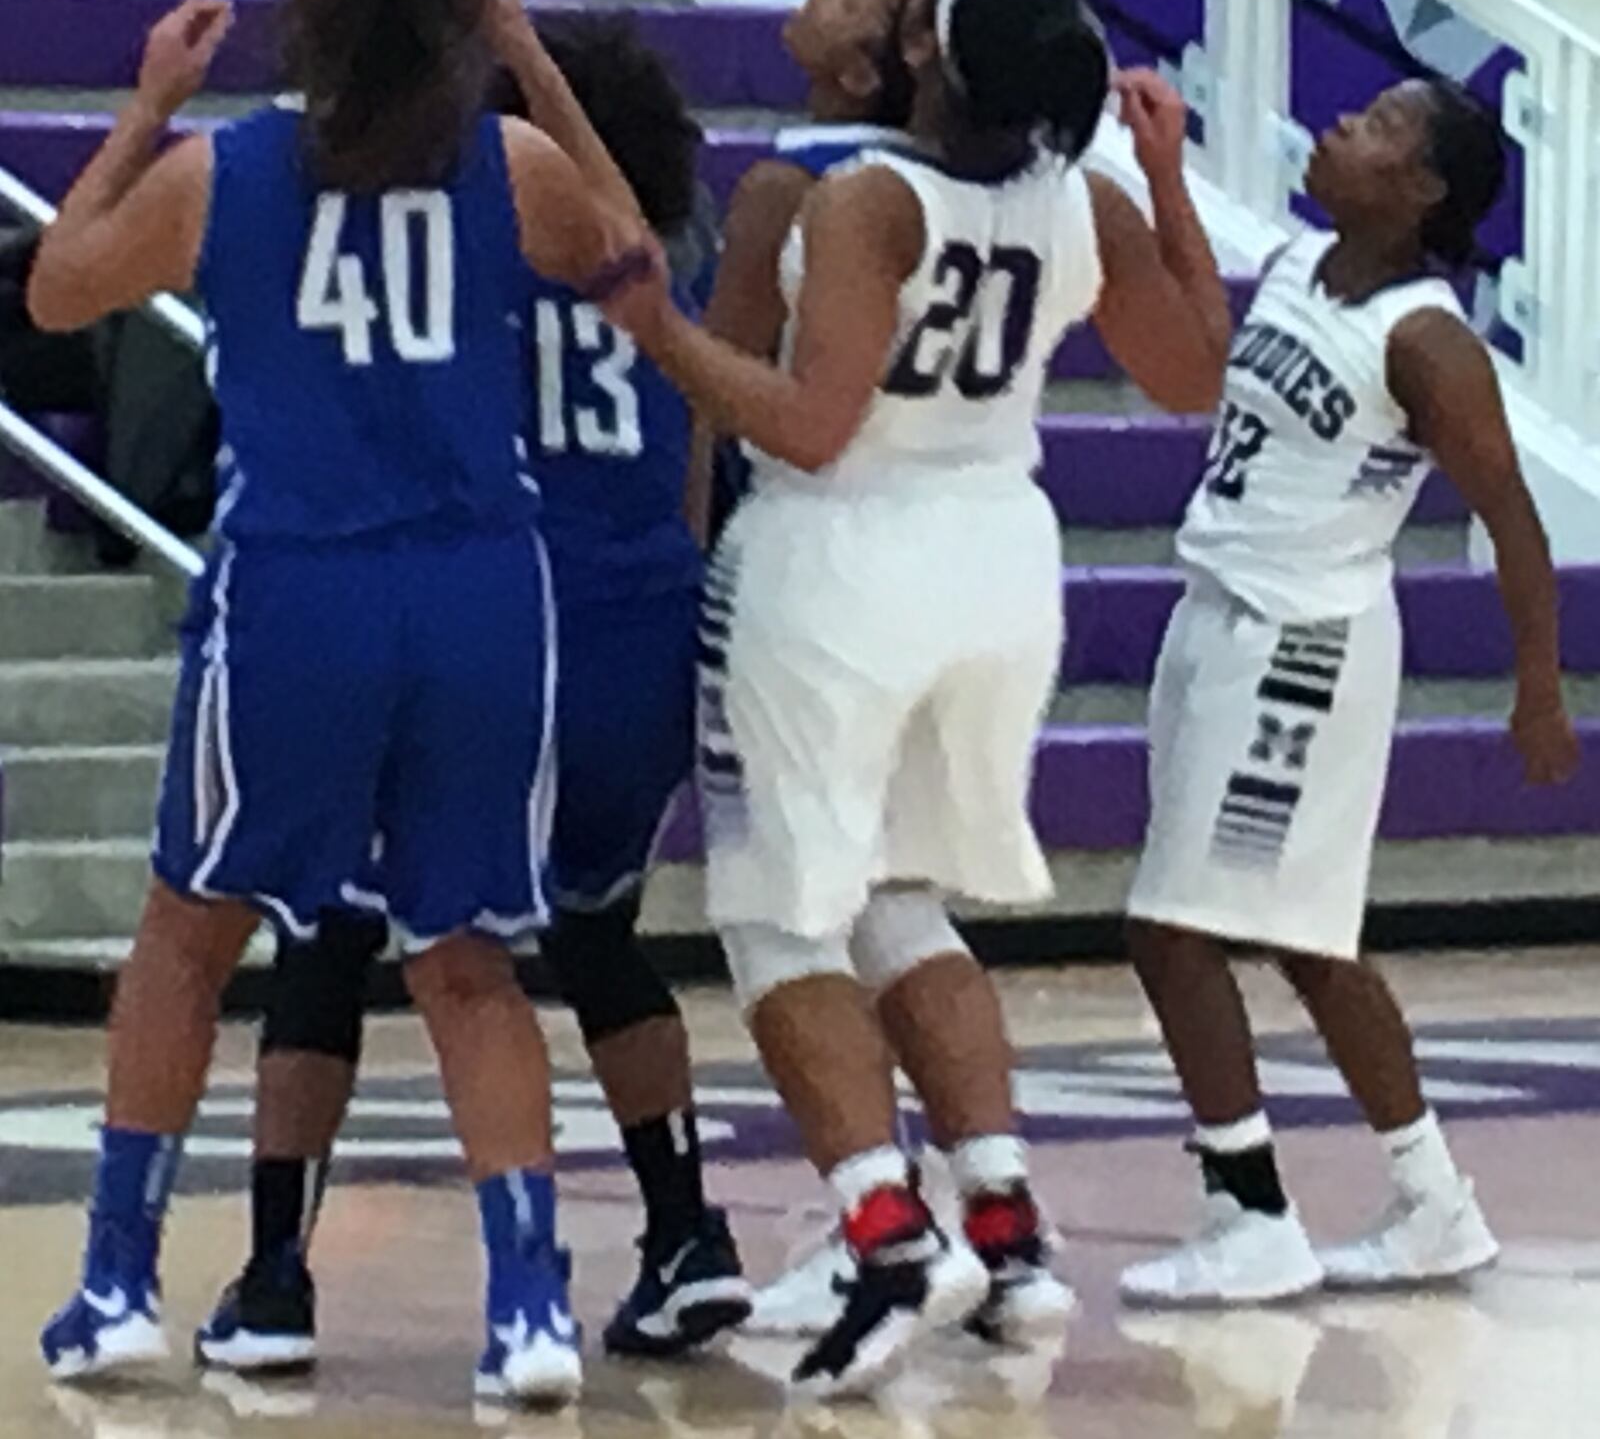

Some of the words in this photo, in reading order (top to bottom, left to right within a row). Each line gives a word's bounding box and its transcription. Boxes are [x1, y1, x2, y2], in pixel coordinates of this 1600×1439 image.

[296, 189, 455, 365] 40
[882, 240, 1044, 399] 20
[535, 298, 644, 457] 13
